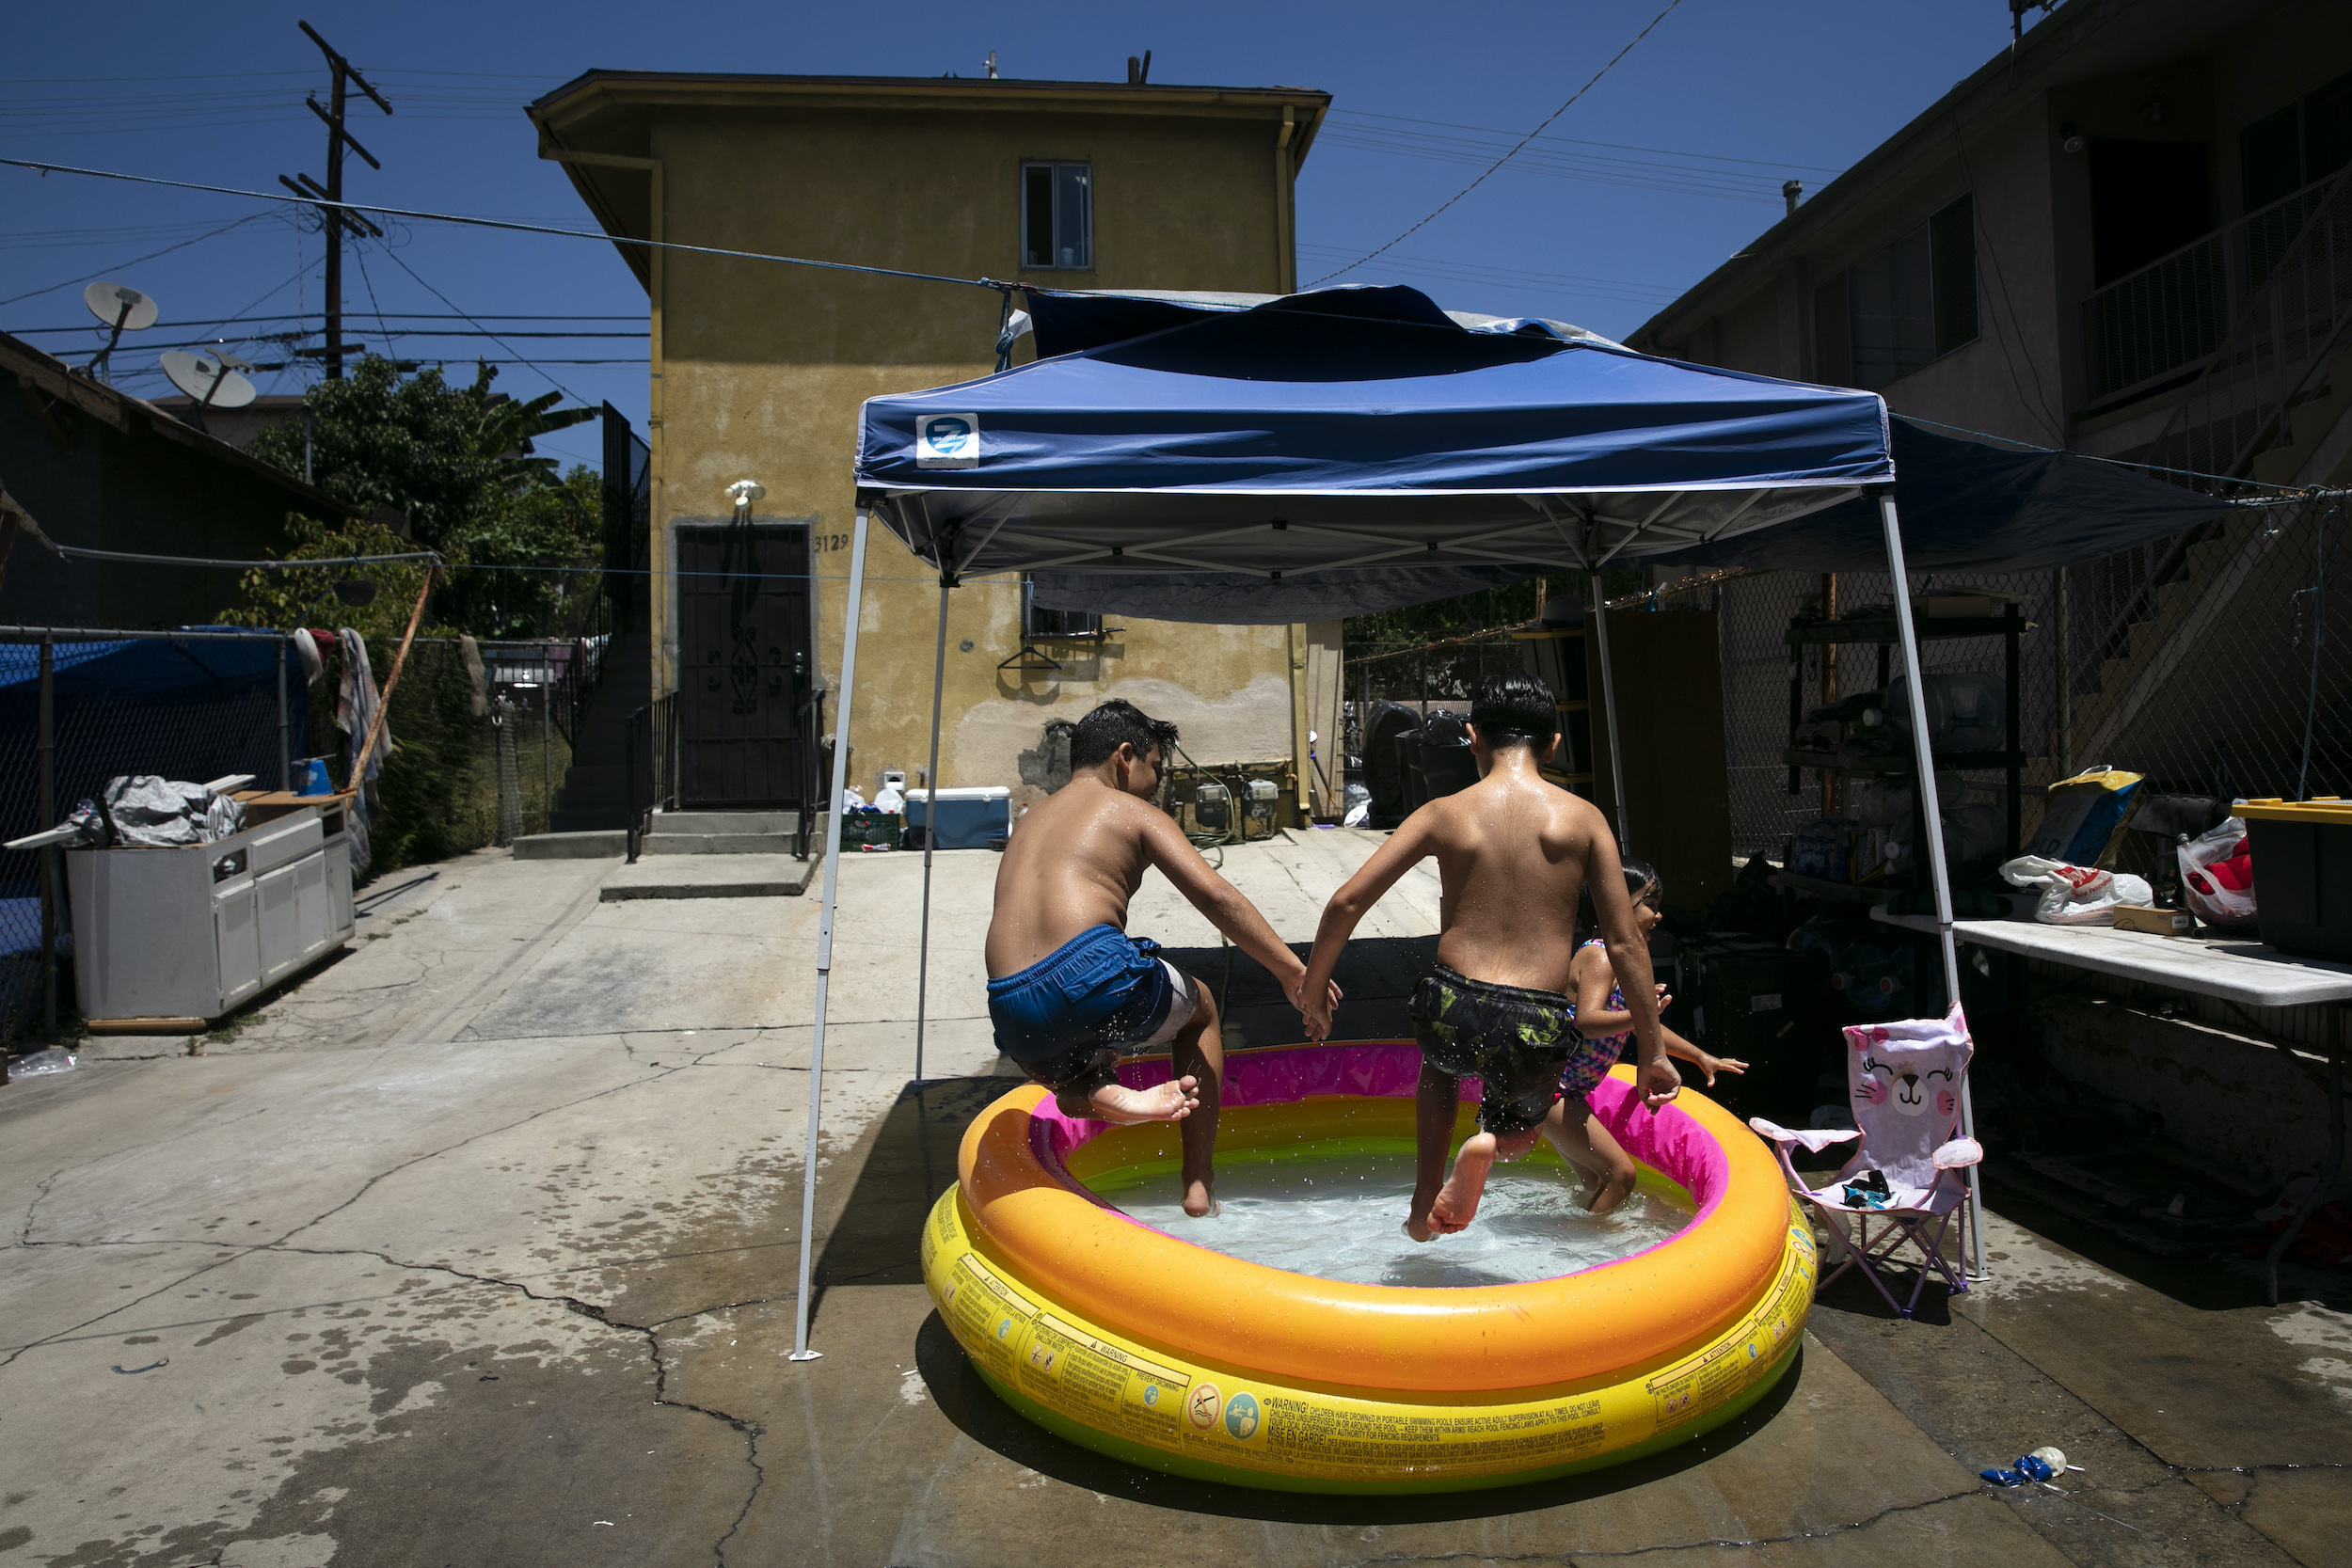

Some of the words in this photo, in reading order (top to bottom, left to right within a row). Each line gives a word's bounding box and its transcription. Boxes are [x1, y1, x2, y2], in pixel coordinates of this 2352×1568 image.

[814, 533, 849, 552] 3129
[2089, 876, 2112, 894] EVERYONE
[990, 1279, 1009, 1297] ATTENTION
[1035, 1332, 1052, 1345] SHALLOW
[1052, 1341, 1065, 1353] WATER
[1709, 1341, 1731, 1359] ATTENTION
[1101, 1345, 1128, 1363] WARNING
[1136, 1371, 1155, 1384] PREVENT
[1155, 1377, 1180, 1392] DROWNING
[1270, 1409, 1295, 1420] CHILDREN
[1296, 1413, 1335, 1427] UNSUPERVISED
[1350, 1421, 1372, 1431] AROUND
[1373, 1423, 1382, 1432] THE
[1383, 1424, 1397, 1433] POOL
[1501, 1422, 1520, 1431] FENCING
[1535, 1418, 1549, 1427] APPLY
[1581, 1407, 1601, 1418] CONSULT
[1272, 1397, 1309, 1414] WARNING!
[1310, 1407, 1334, 1417] CHILDREN
[1336, 1411, 1348, 1419] HAVE
[1349, 1412, 1375, 1422] DROWNED
[1382, 1416, 1408, 1425] PORTABLE
[1409, 1418, 1435, 1426] SWIMMING
[1454, 1418, 1473, 1426] ENSURE
[1492, 1416, 1507, 1424] ADULT
[1508, 1412, 1538, 1422] SUPERVISION
[1546, 1409, 1554, 1418] ALL
[1577, 1402, 1585, 1411] NOT
[1586, 1400, 1600, 1409] LEAVE
[1267, 1425, 1285, 1439] MISE
[1287, 1430, 1296, 1441] EN
[1298, 1431, 1327, 1446] GARDE!
[1328, 1438, 1338, 1447] DES
[1339, 1439, 1360, 1449] ENFANTS
[1361, 1441, 1368, 1449] SE
[1268, 1417, 1283, 1427] YOUR
[1284, 1419, 1300, 1430] LOCAL
[1302, 1423, 1337, 1435] GOVERNMENT
[1337, 1428, 1366, 1438] AUTHORITY
[1377, 1432, 1399, 1440] FENCING
[1184, 1433, 1207, 1444] RELATIVES
[1218, 1442, 1244, 1453] BARRIERES
[1267, 1437, 1284, 1448] ACTIVE
[1286, 1441, 1296, 1449] PAR
[1297, 1442, 1307, 1451] DES
[1341, 1449, 1362, 1457] LAISSEZ
[1423, 1449, 1460, 1458] SURVEILLANCE
[1482, 1447, 1502, 1455] AUTOUR
[1283, 1449, 1293, 1457] SUR
